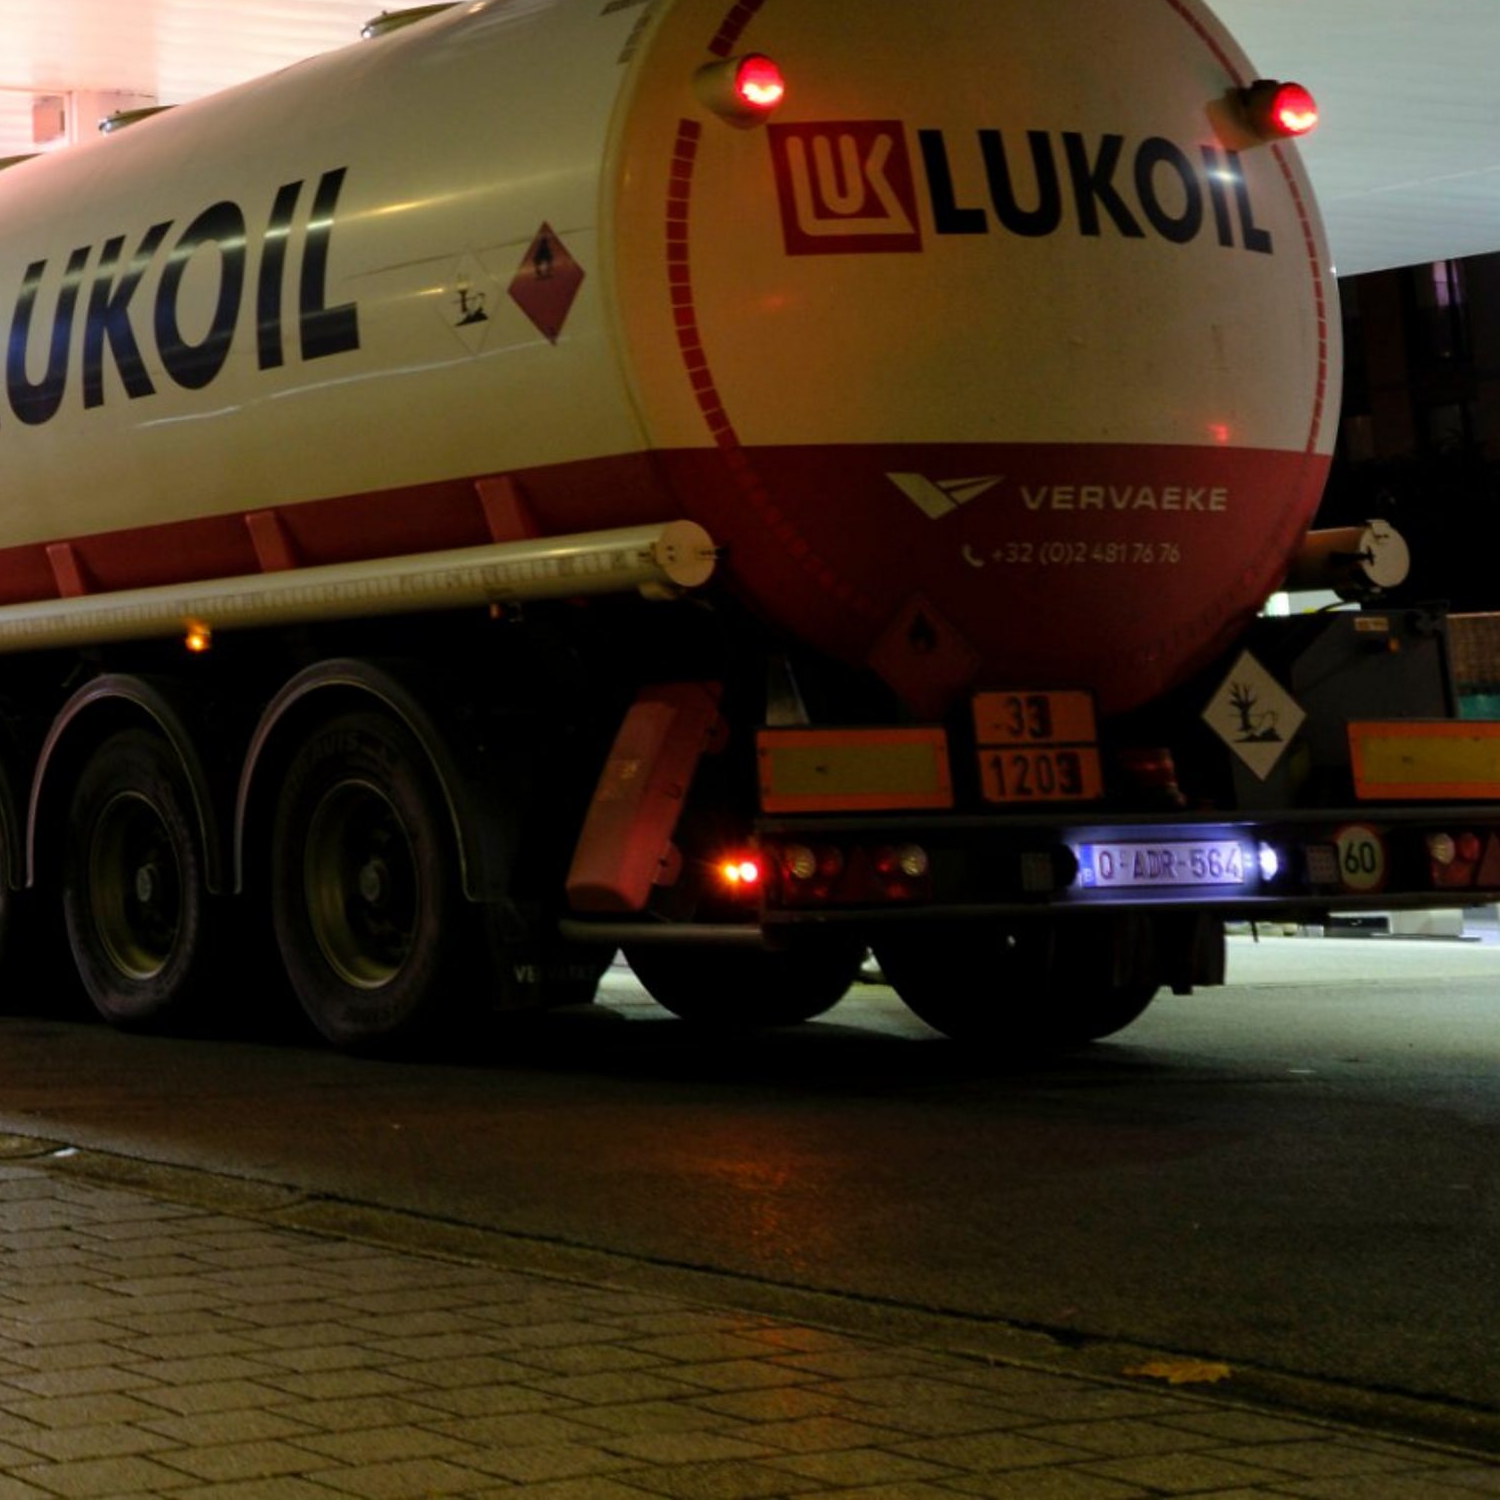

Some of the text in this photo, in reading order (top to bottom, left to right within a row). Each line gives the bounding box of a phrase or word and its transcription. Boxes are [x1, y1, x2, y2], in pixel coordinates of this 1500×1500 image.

[786, 129, 1274, 255] LUK LUKOIL
[1019, 485, 1228, 512] VERVAEKE
[992, 543, 1033, 563] +32
[1008, 695, 1052, 739] 33
[990, 751, 1084, 797] 1203
[1344, 840, 1377, 874] 60
